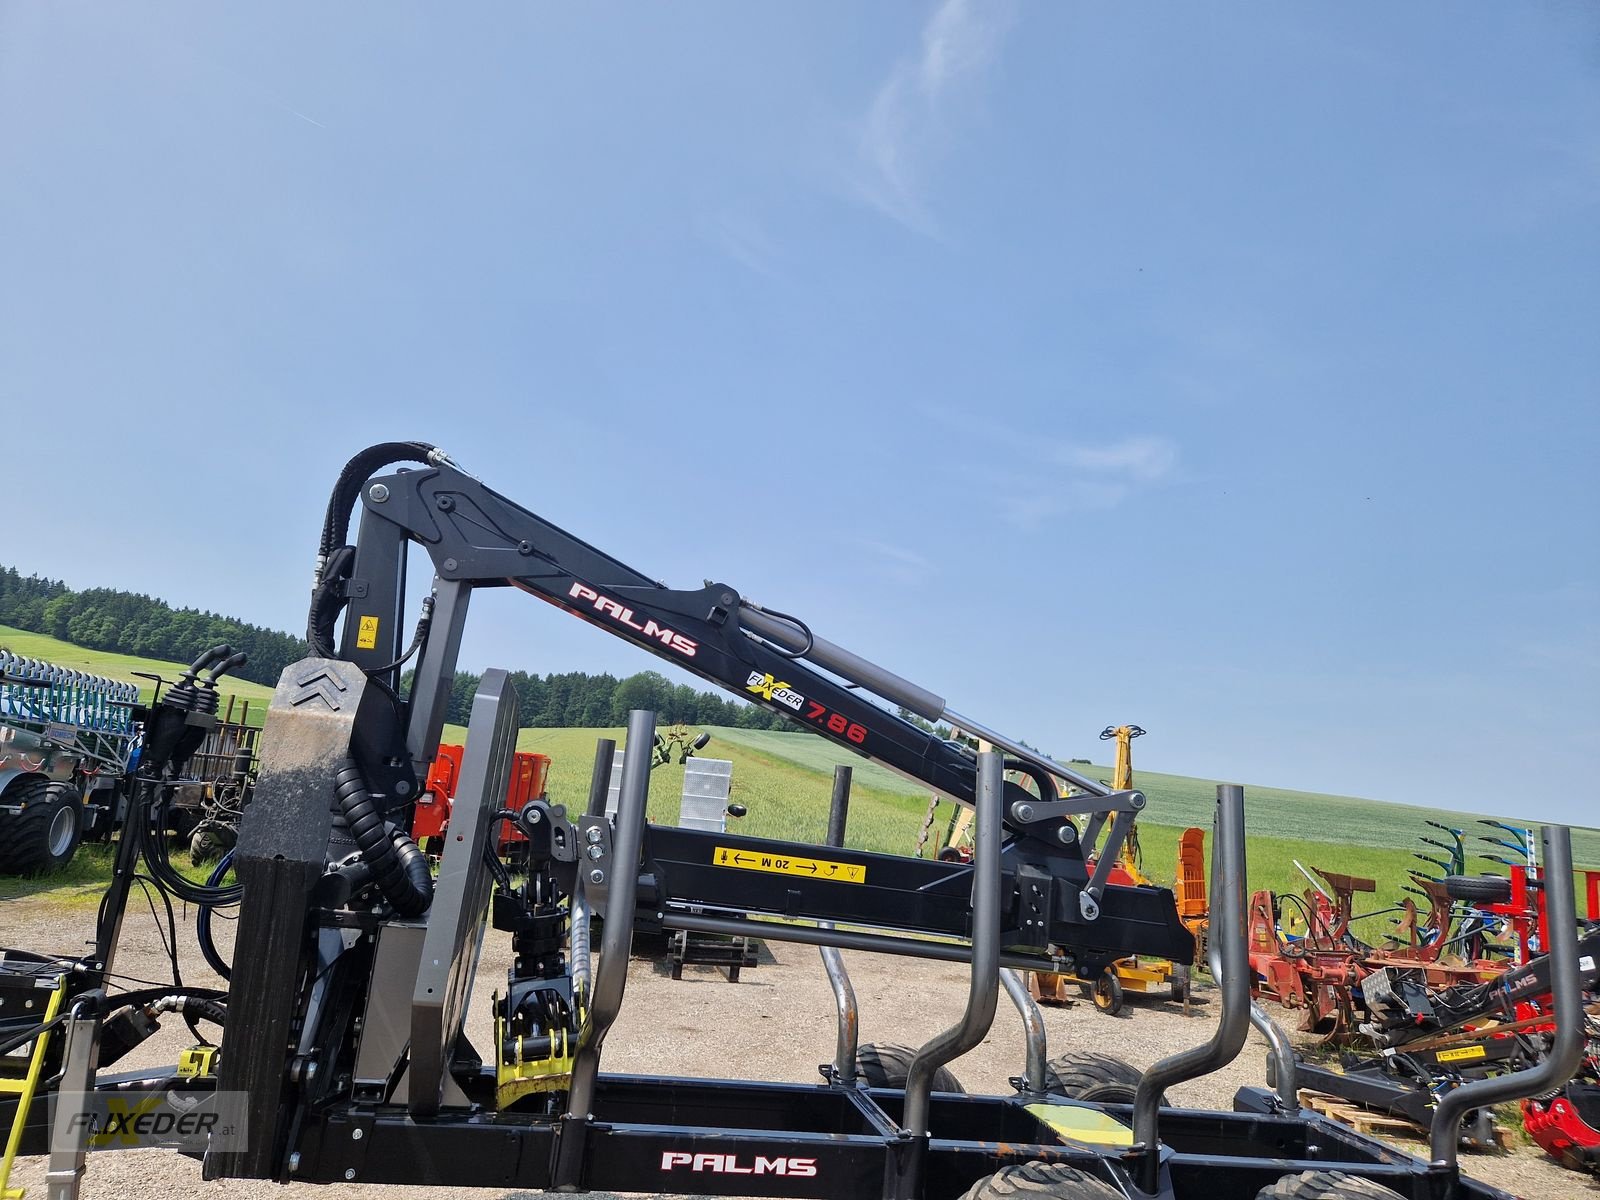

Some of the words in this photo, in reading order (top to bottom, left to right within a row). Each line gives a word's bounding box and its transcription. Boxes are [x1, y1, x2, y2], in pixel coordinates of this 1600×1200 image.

[568, 581, 699, 657] PALMS
[807, 700, 868, 744] 7.86
[761, 857, 772, 868] M
[775, 859, 790, 870] 20
[660, 1151, 818, 1177] PALMS
